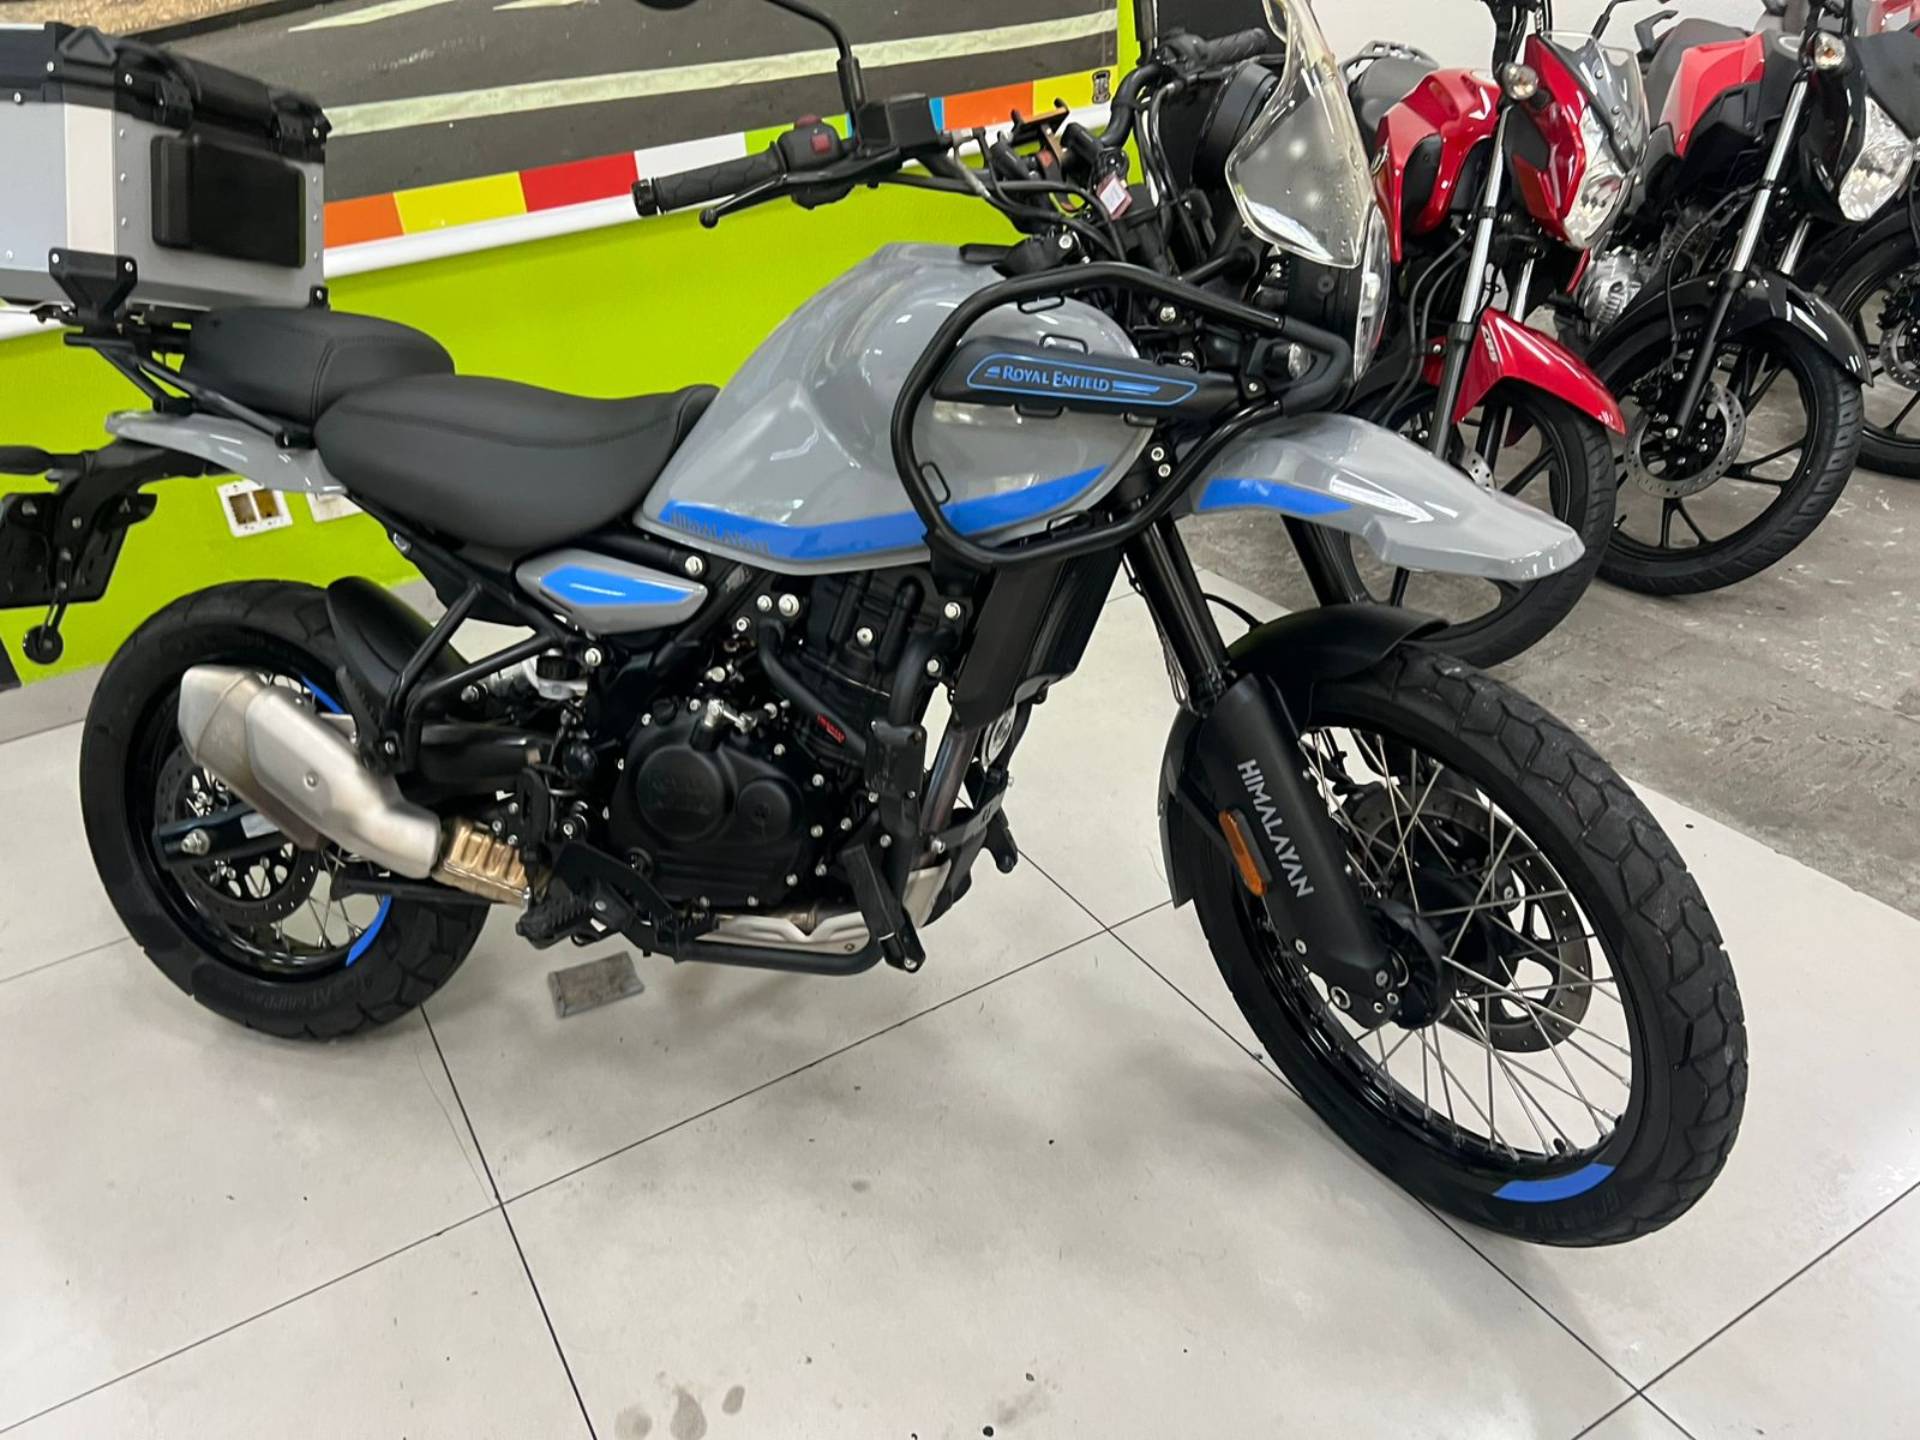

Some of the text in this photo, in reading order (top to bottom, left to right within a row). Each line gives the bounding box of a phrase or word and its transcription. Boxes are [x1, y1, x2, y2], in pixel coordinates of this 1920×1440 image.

[1002, 365, 1110, 392] ROYAL ENFIELD
[1237, 759, 1315, 897] HIMALAYAN
